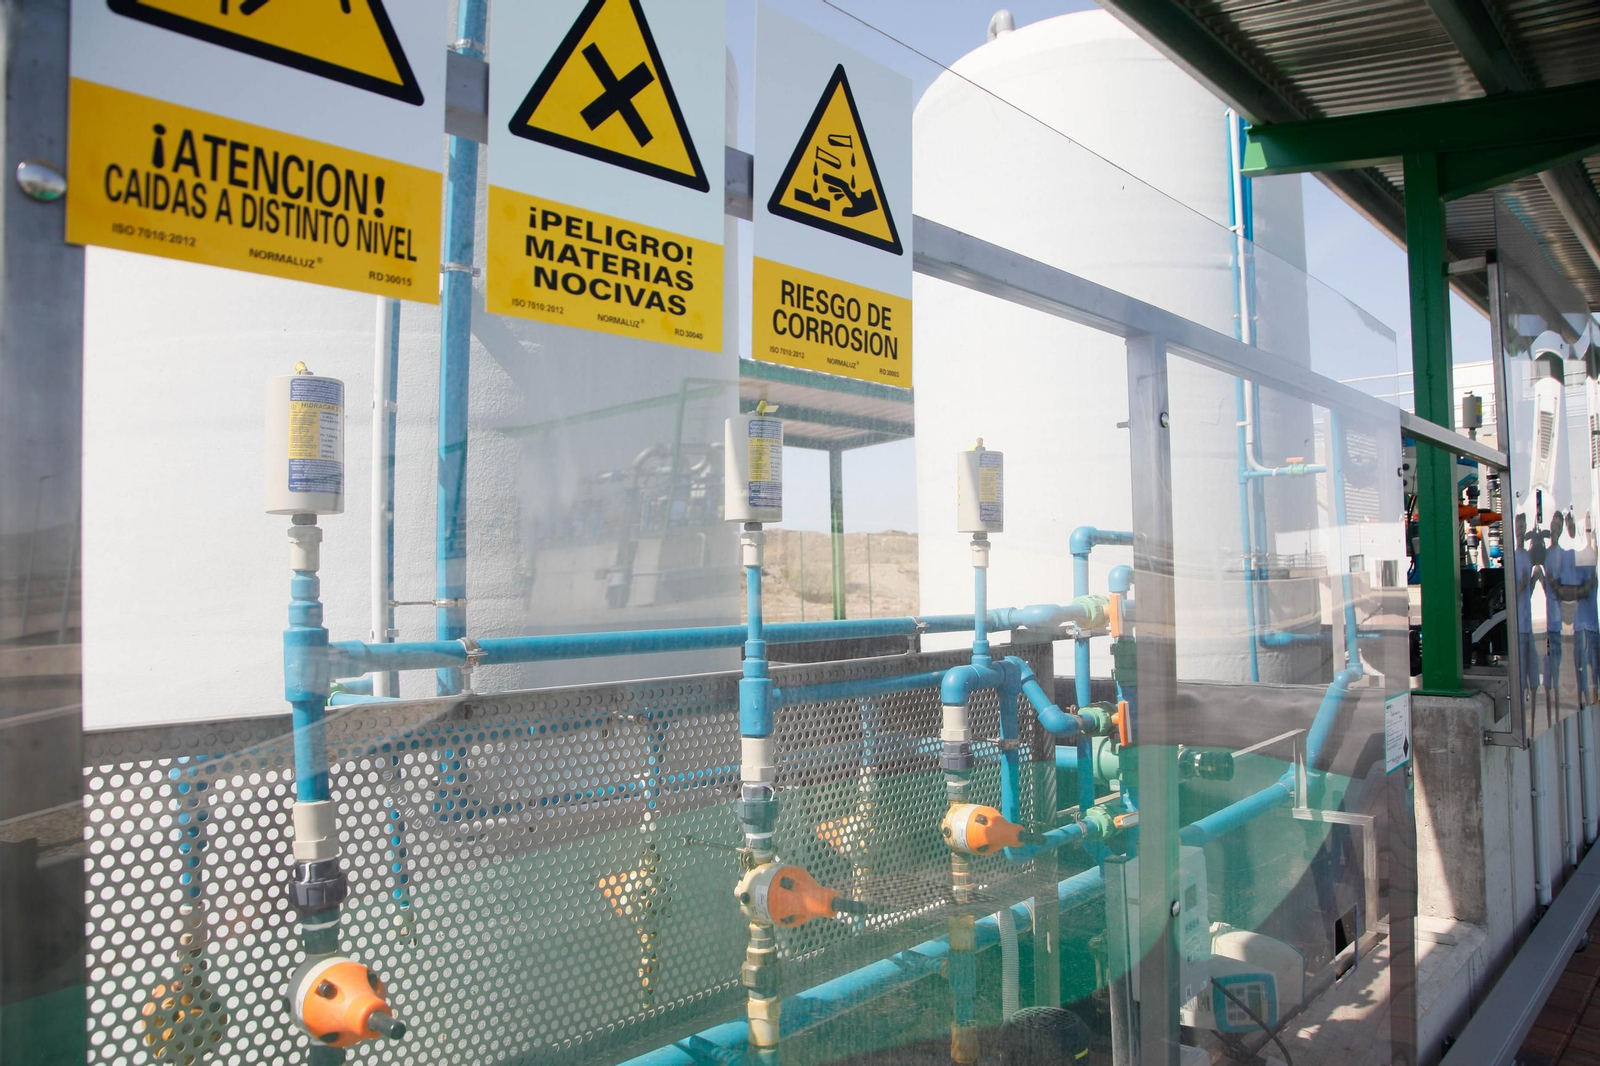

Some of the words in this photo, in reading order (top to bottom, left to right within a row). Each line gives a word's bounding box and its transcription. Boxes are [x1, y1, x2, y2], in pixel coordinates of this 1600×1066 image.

[151, 123, 386, 218] ¡ATENCION!
[105, 163, 207, 219] CAIDAS
[215, 188, 233, 225] A
[241, 193, 350, 248] DISTINTO
[356, 218, 418, 262] NIVEL
[111, 222, 136, 238] ISO
[137, 226, 197, 247] 7010:2012
[528, 206, 693, 266] ¡PELIGRO!
[525, 234, 694, 292] MATERIAS
[511, 297, 526, 309] ISO
[527, 300, 564, 315] 7010:2012
[533, 265, 687, 316] NOCIVAS
[781, 279, 861, 323] RIESGO
[868, 302, 892, 331] DE
[769, 345, 779, 355] ISO
[772, 309, 898, 360] CORROSION
